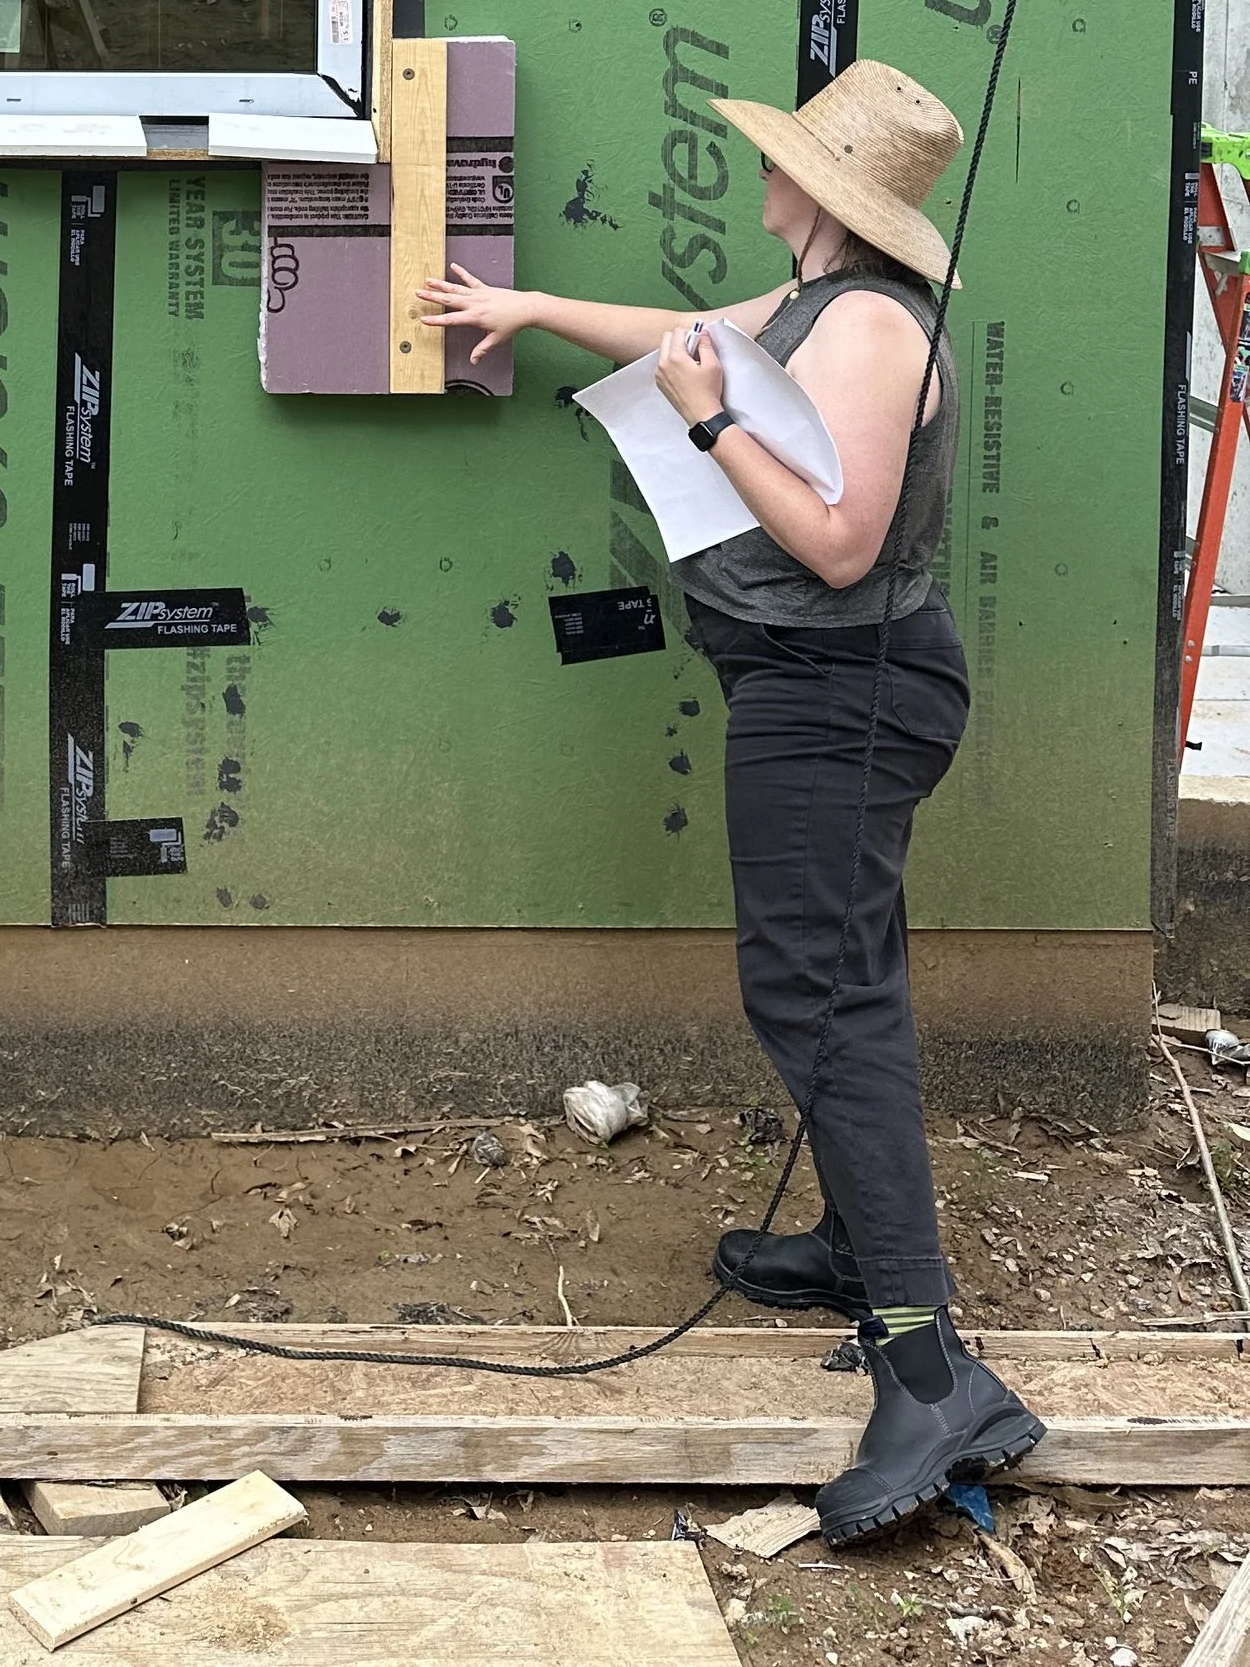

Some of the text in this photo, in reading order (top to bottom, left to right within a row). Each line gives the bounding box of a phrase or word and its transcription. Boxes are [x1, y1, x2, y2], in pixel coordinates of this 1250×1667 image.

[168, 240, 181, 318] WARRANTY
[184, 177, 206, 321] YEAR SYSTEM
[64, 406, 74, 486] FLASHING TAPE
[78, 360, 100, 463] ZIPsystem
[1176, 384, 1187, 464] FLASHING TAPE
[979, 320, 1004, 586] WATER-RESISTIVE & AIR
[111, 602, 212, 624] ZIPsystem
[158, 624, 237, 635] FLASHING TAPE
[617, 599, 644, 610] TAPE
[61, 787, 70, 837] FLASHING
